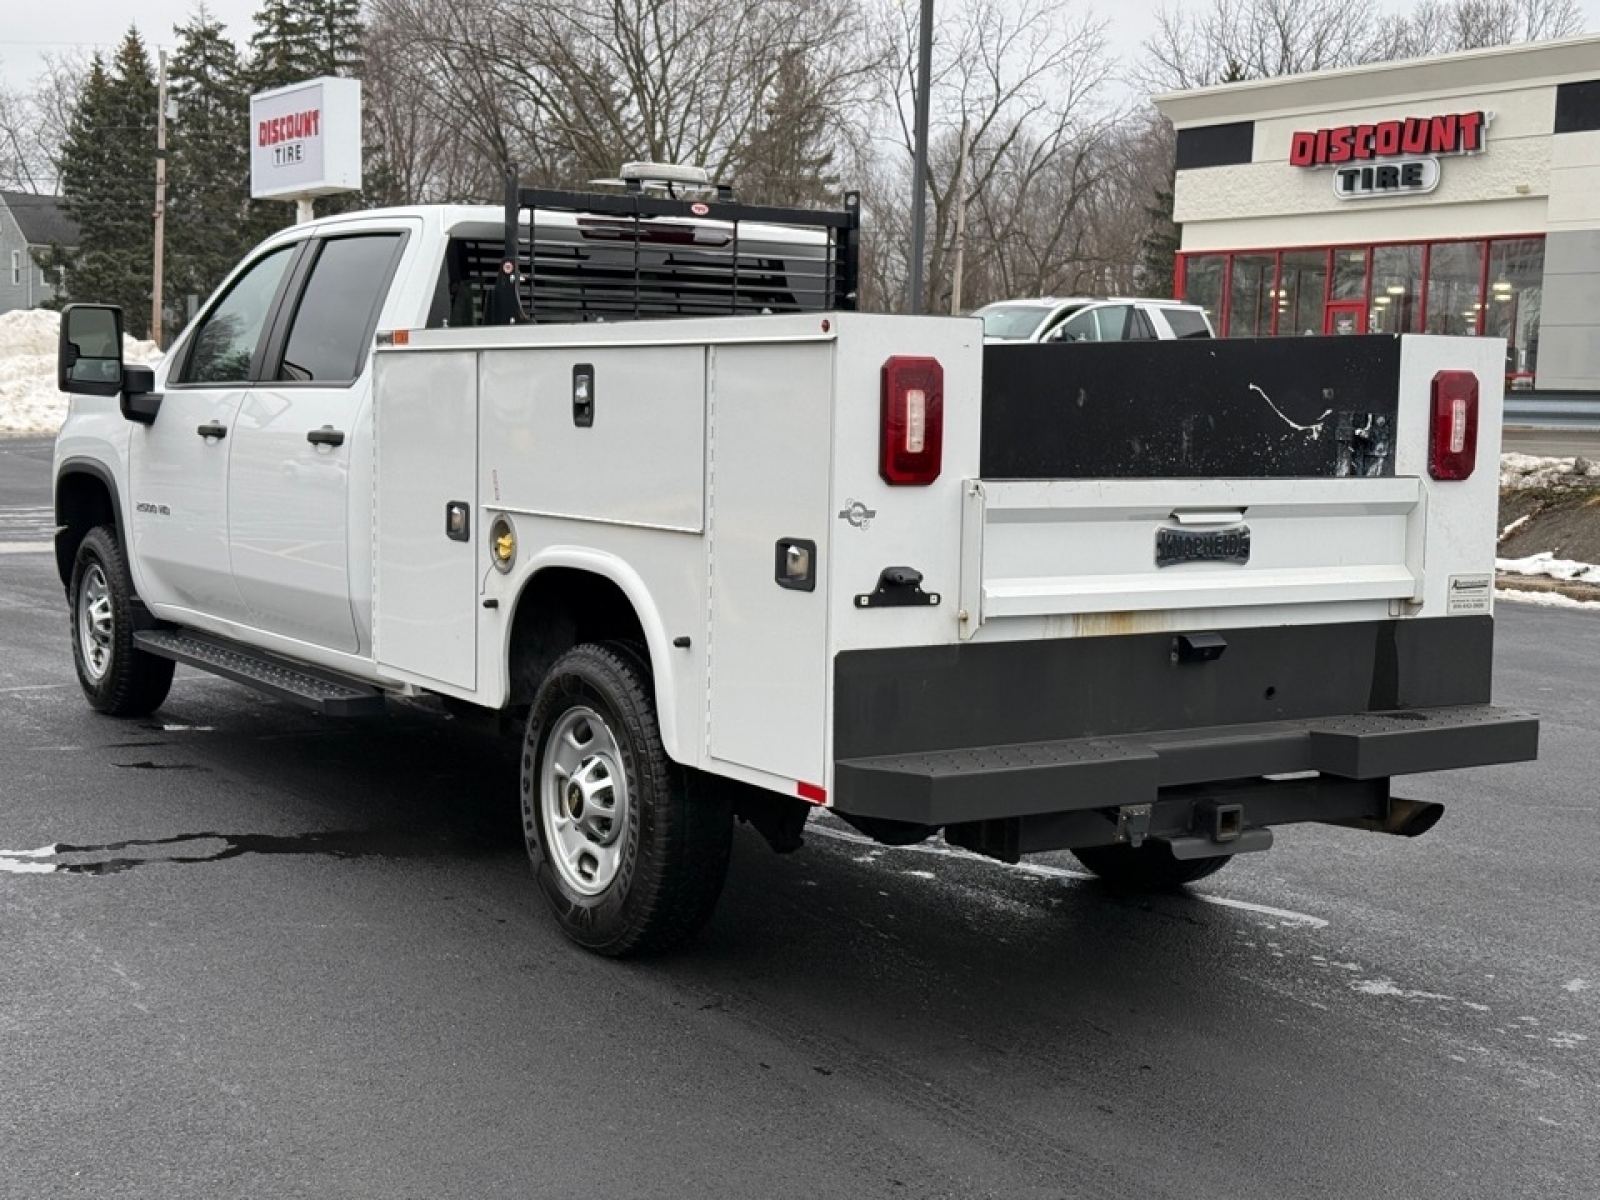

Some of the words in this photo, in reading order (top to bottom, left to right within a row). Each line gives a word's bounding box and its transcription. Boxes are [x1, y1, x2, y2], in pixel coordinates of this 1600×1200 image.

[258, 109, 320, 147] DISCOUNT
[1290, 111, 1485, 167] DISCOUNT
[274, 144, 303, 164] TIRE
[1337, 162, 1424, 191] TIRE
